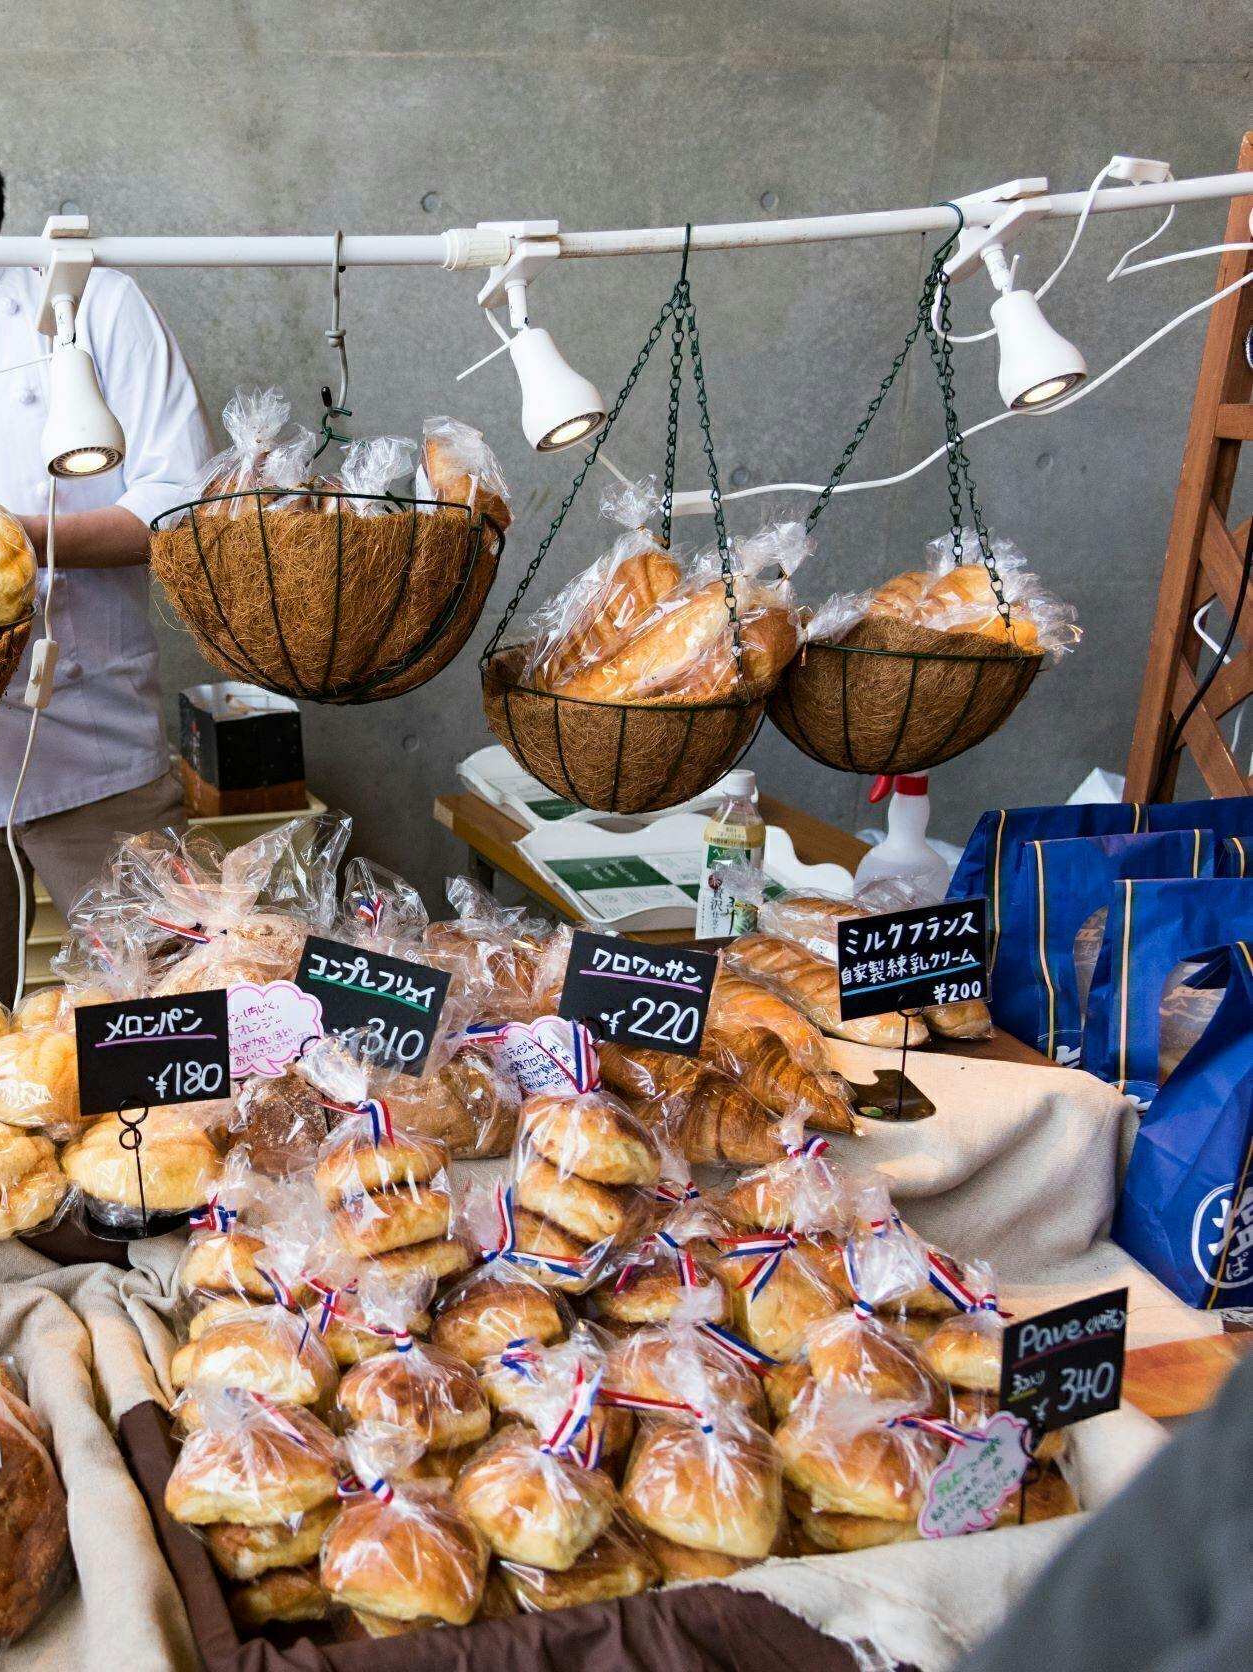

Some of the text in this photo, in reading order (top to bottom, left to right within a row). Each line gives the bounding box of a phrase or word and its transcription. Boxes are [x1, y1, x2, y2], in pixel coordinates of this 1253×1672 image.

[845, 911, 979, 954] ミルクフランス
[591, 947, 702, 984] クロワッサン
[841, 948, 977, 985] 自家製練乳クリーム
[933, 980, 982, 1005] ¥200
[105, 1007, 203, 1041] メロンパン
[599, 997, 700, 1044] ¥220
[146, 1060, 224, 1100] ¥180
